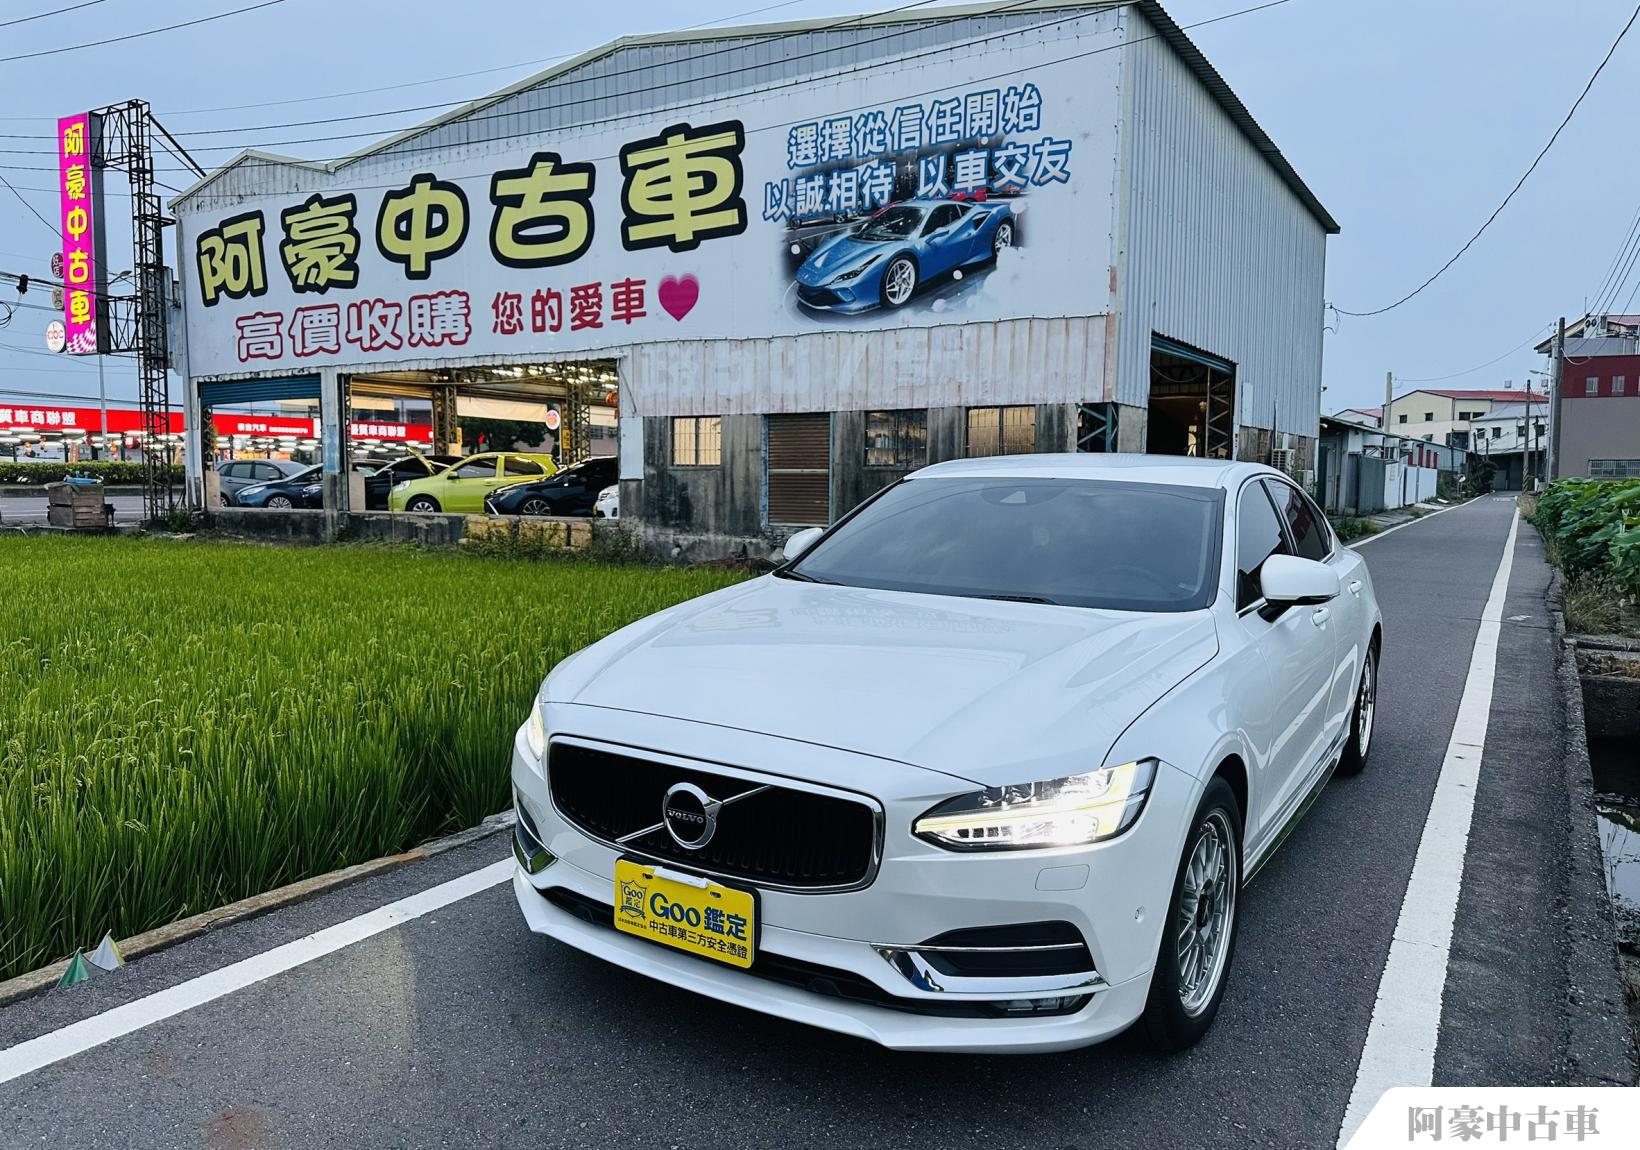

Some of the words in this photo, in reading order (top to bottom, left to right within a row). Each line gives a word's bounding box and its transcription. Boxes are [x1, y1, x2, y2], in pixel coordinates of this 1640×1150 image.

[787, 83, 1042, 169] 選擇從信任開始
[63, 121, 91, 326] 阿豪中古車
[197, 120, 747, 307] 阿豪中古車
[763, 161, 897, 224] 以誠相待
[915, 138, 1072, 201] 以車交友
[236, 289, 472, 363] 高價收購
[491, 277, 648, 336] 您的愛車
[667, 809, 704, 824] VOLVO
[623, 886, 643, 899] Goo
[650, 893, 701, 927] Goo
[704, 906, 747, 942] 鑑定
[649, 920, 748, 960] 中古車第三方安全憑證
